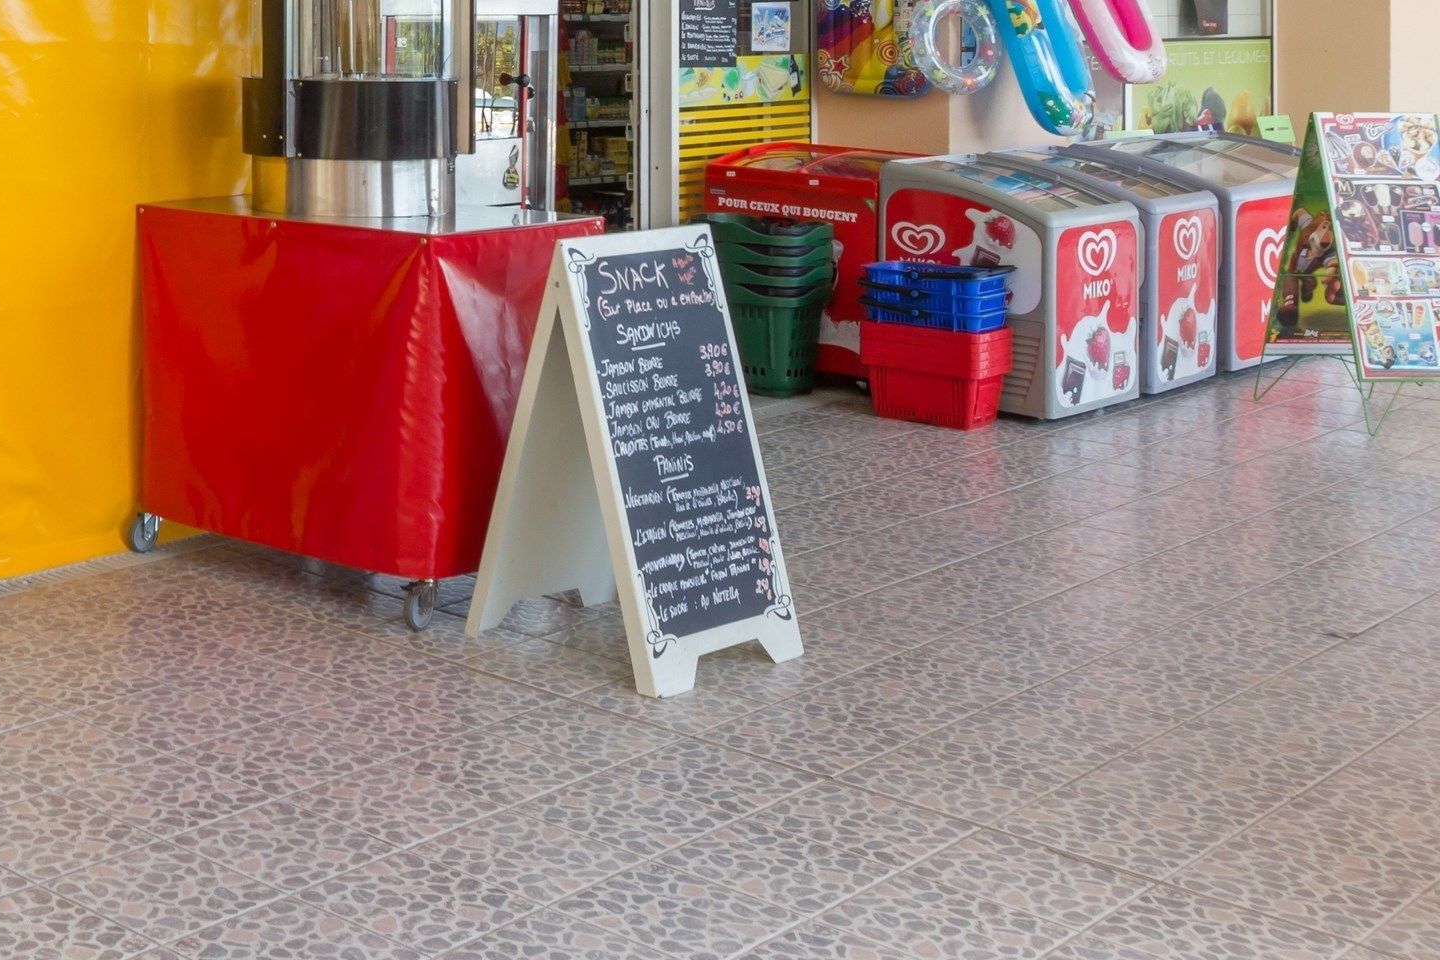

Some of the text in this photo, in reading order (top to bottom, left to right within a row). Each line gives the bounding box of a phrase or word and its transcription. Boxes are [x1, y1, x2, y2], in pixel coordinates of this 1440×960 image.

[1167, 52, 1201, 66] RUITS
[1203, 51, 1216, 65] ET
[718, 196, 858, 223] POUR CEUX QUI BOUGENT
[598, 260, 669, 294] SNACK
[1177, 265, 1198, 282] MIKO
[1083, 279, 1111, 300] MIKO
[601, 343, 727, 378] JAMBON BEURRE 3,90€
[652, 374, 678, 391] BEURRE
[705, 361, 730, 377] 3,90€
[609, 401, 639, 419] JAMBON
[677, 388, 702, 404] BEURRE
[714, 381, 740, 400] 4,20€
[611, 421, 643, 438] JAMBON
[646, 415, 660, 430] CRU
[664, 410, 691, 429] BEURRE
[715, 401, 740, 417] 4,20€
[717, 420, 743, 434] 4,50€
